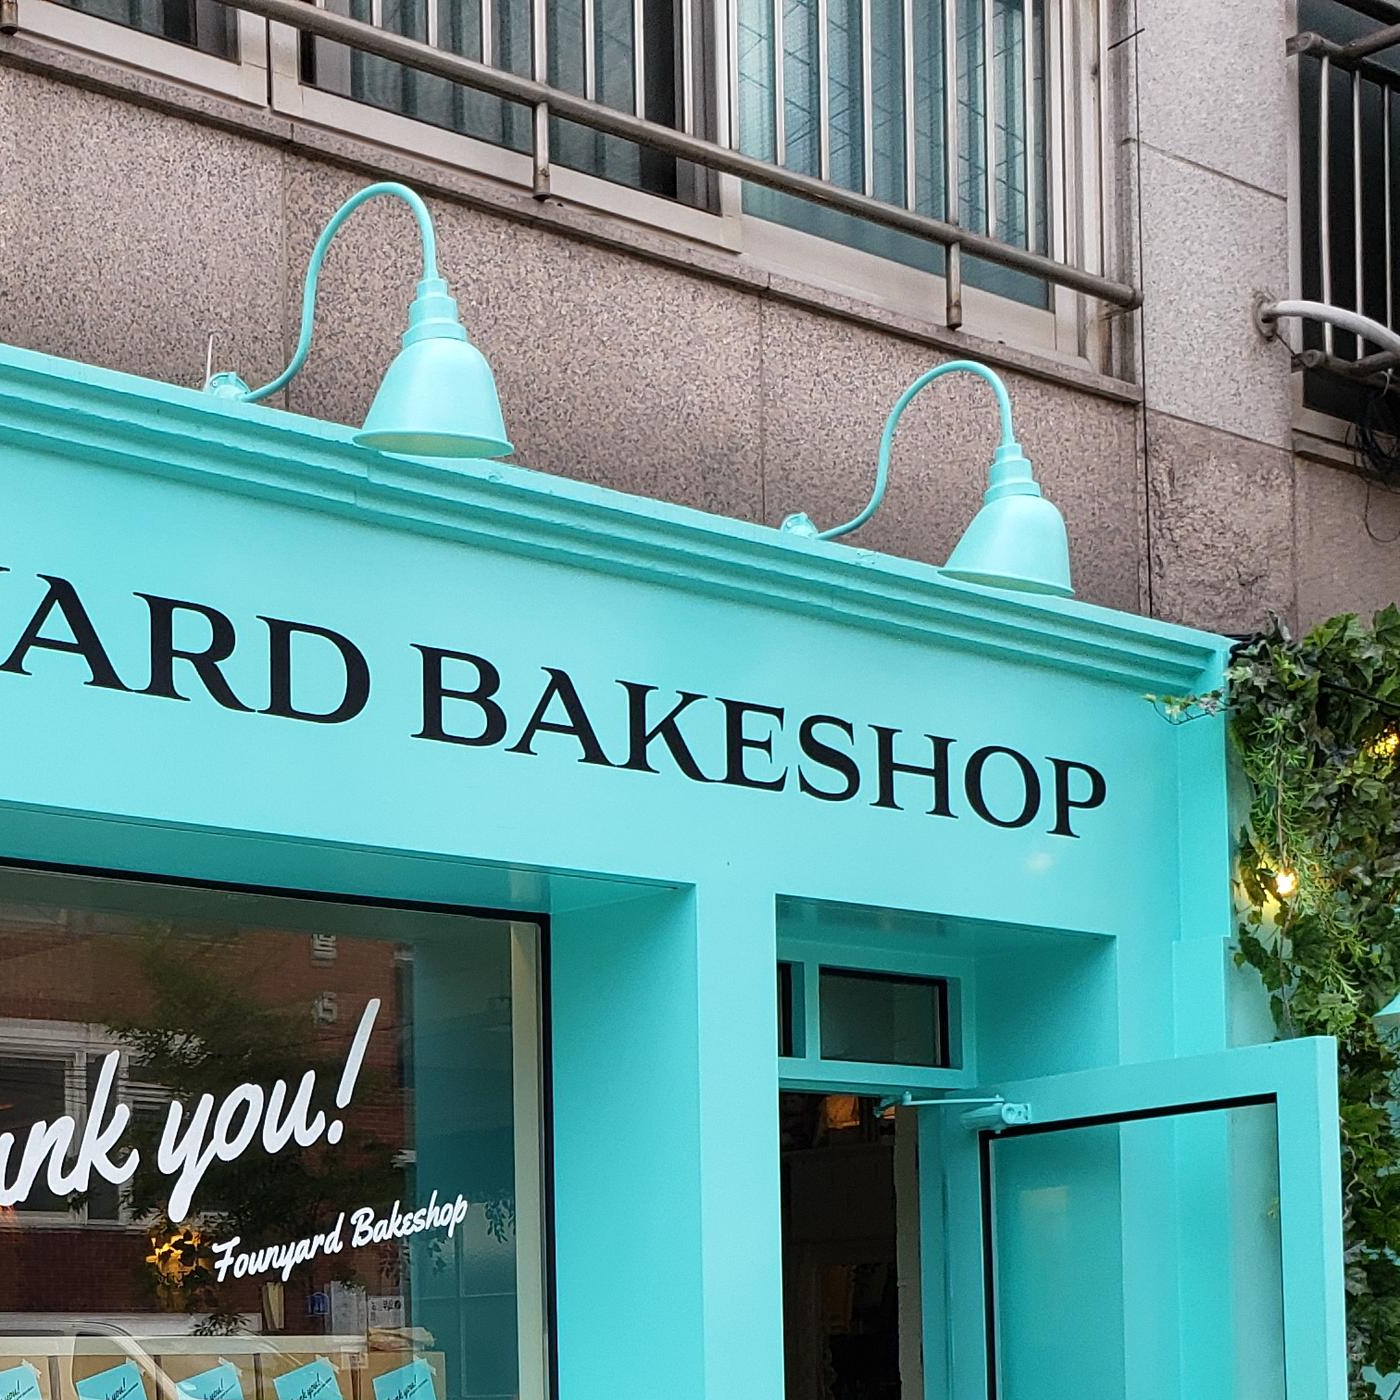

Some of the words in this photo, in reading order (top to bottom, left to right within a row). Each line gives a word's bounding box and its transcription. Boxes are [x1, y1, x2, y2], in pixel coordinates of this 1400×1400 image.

[410, 643, 1107, 839] BAKESHOP
[157, 998, 380, 1223] you!
[212, 1212, 344, 1282] Founyard
[349, 1190, 468, 1248] Bakeshop
[308, 1372, 320, 1398] you!
[404, 1374, 417, 1398] you!
